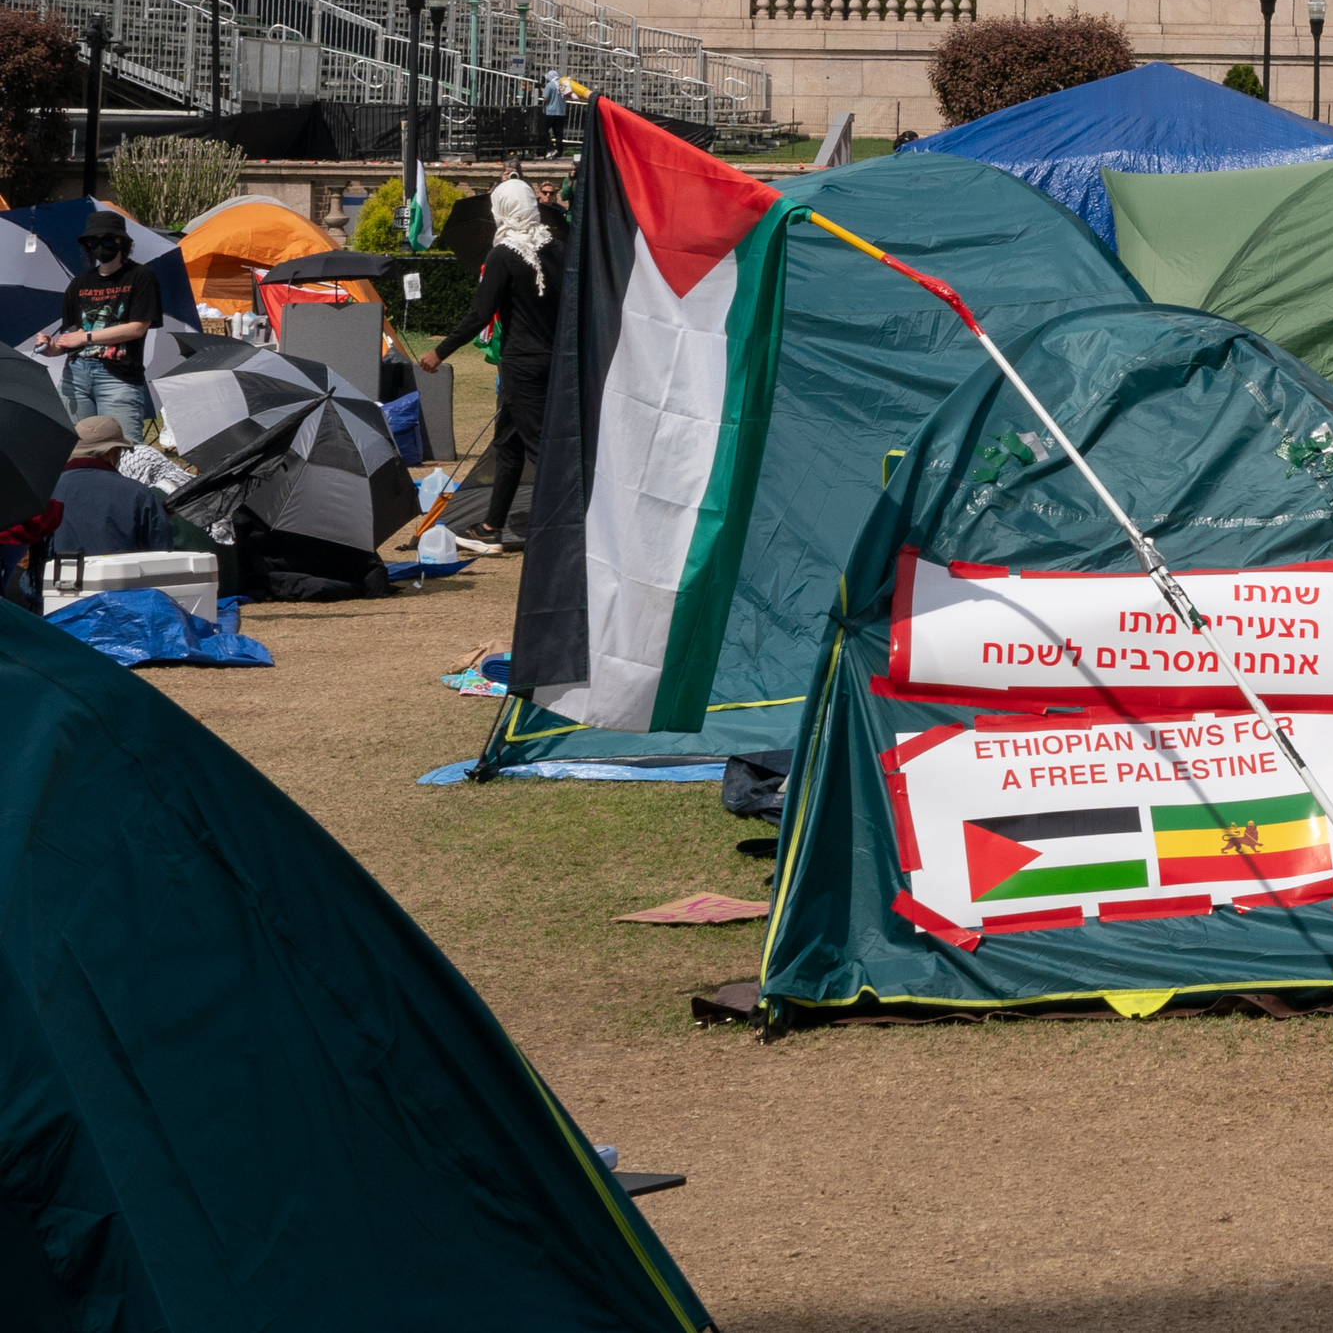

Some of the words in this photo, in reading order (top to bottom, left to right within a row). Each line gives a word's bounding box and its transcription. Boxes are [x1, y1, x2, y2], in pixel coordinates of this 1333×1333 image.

[78, 288, 105, 297] DEATH
[1233, 583, 1320, 605] שמתו
[1118, 610, 1177, 634] מתו
[982, 638, 1083, 667] לשכוח
[1096, 646, 1219, 672] מסרבים
[1234, 651, 1319, 676] אנחנו
[974, 730, 1134, 760] ETHIOPIAN
[1142, 724, 1225, 751] JEWS
[1234, 715, 1295, 744] FOR
[1001, 769, 1023, 790] A
[1029, 763, 1108, 788] FREE
[1116, 751, 1278, 783] PALESTINE
